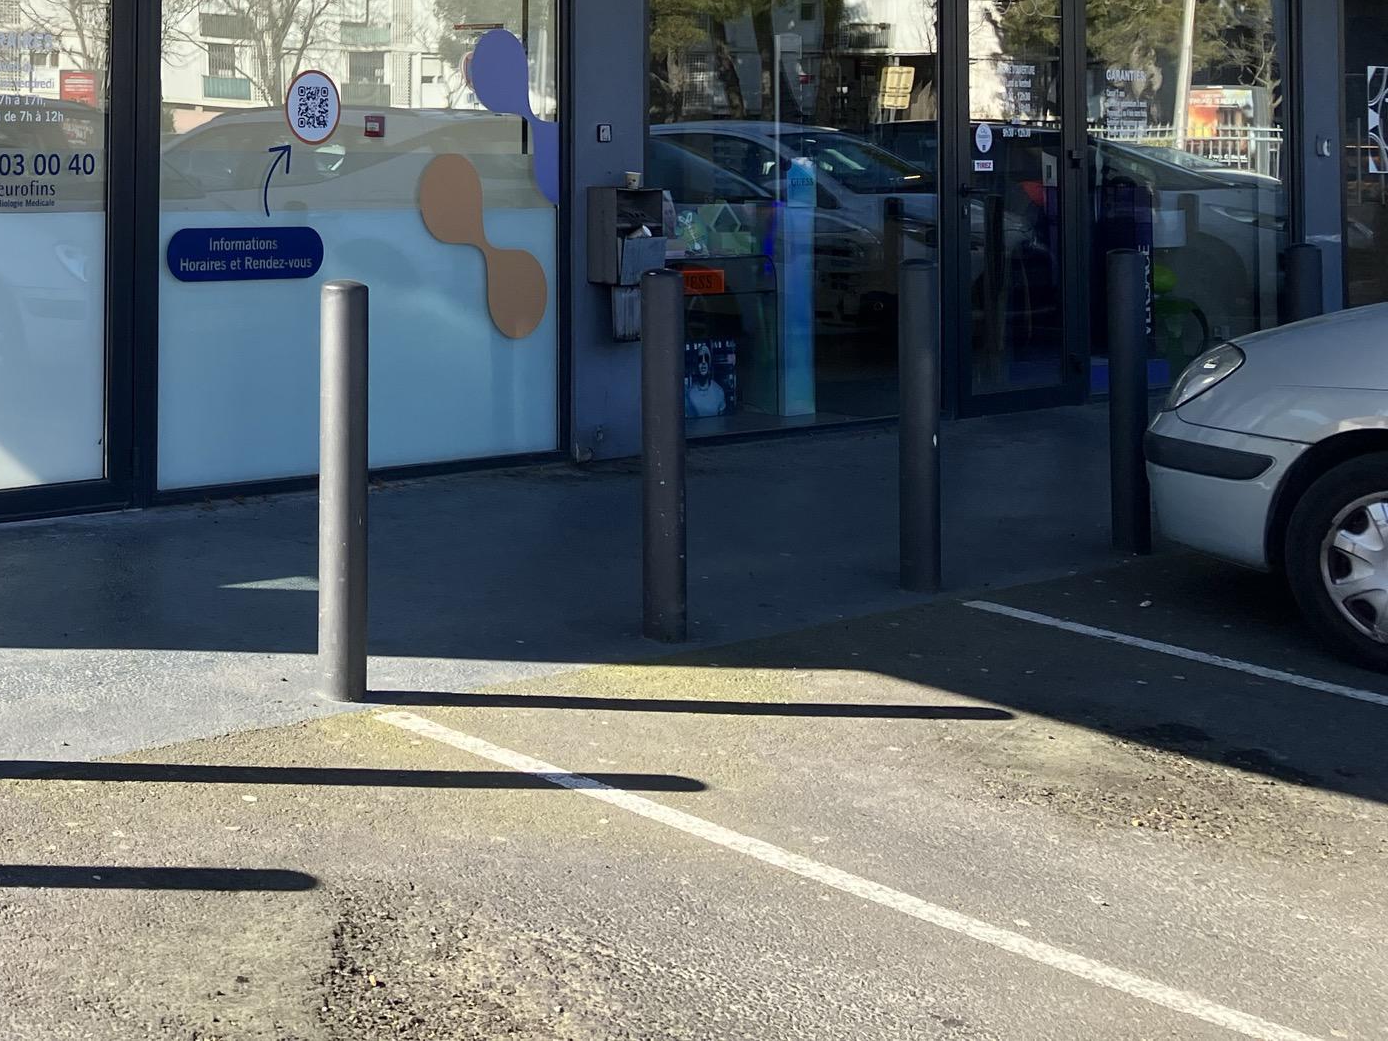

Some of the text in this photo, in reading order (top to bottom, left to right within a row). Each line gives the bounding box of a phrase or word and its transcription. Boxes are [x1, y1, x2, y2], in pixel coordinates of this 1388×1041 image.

[0, 94, 12, 105] 7h
[4, 111, 17, 122] de
[19, 111, 33, 122] 7h
[35, 111, 41, 122] à
[45, 111, 64, 122] 12h
[33, 154, 61, 176] 00
[68, 154, 95, 176] 40
[209, 237, 278, 252] Informations
[179, 256, 313, 272] Horaires et Rendez-vous
